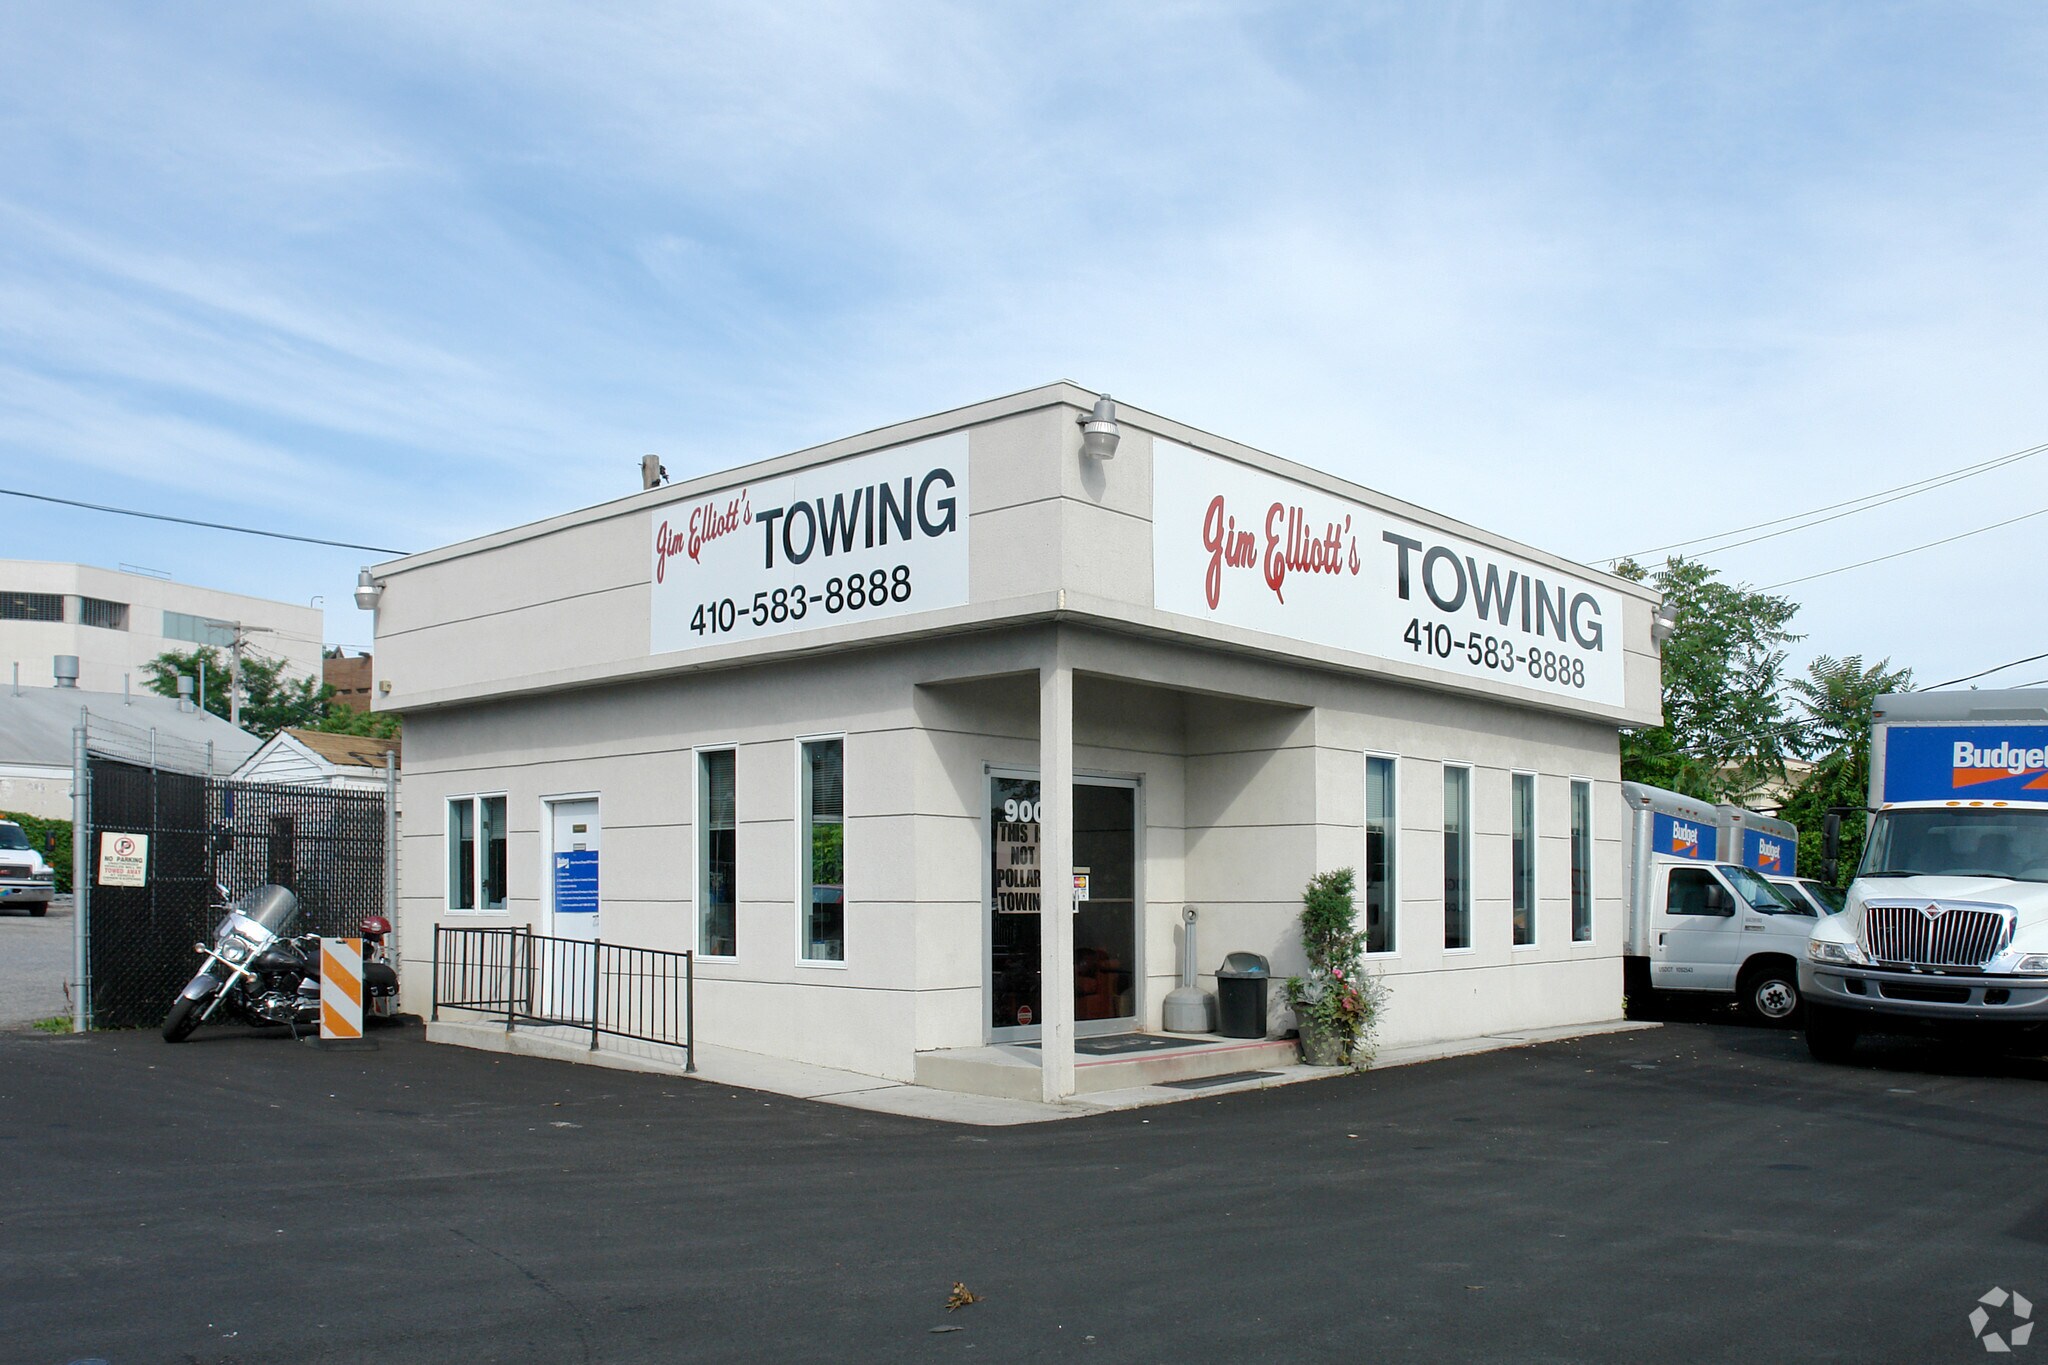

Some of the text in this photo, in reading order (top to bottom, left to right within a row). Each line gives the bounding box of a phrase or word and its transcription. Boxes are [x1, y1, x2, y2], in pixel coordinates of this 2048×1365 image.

[656, 467, 957, 584] Jim Elliott's TOWING
[1202, 494, 1604, 652] Jim Elliott's TOWING
[689, 564, 912, 636] 410-583-8888
[1403, 617, 1586, 690] 410-583-8888
[1000, 823, 1041, 844] THIS I
[1673, 820, 1699, 846] Budget
[116, 856, 143, 864] PARKING
[1010, 846, 1036, 865] NOT
[1759, 837, 1781, 860] Budget
[996, 868, 1042, 888] POLLAR
[998, 891, 1042, 912] TOWIN
